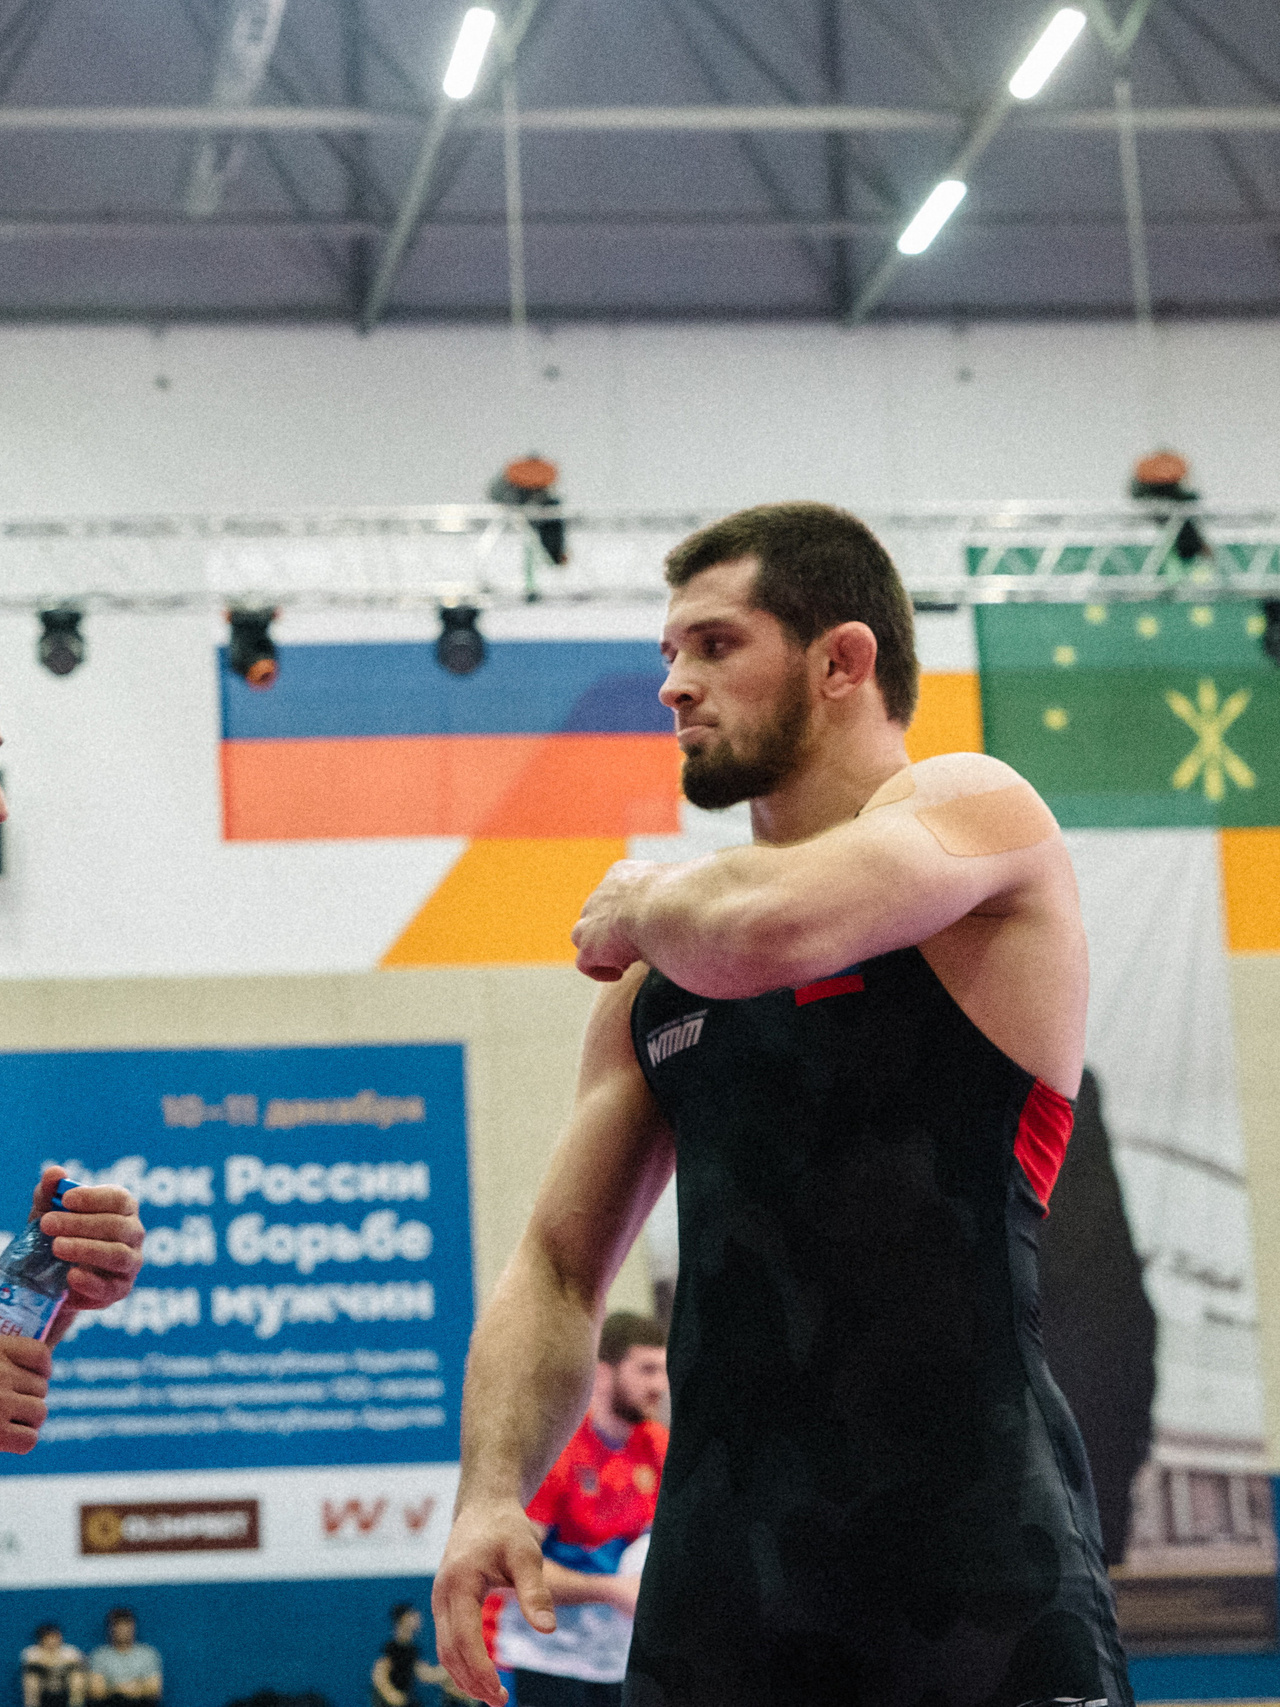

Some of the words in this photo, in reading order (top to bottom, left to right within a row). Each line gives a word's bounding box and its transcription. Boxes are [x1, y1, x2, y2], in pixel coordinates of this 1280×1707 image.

[224, 1153, 431, 1204] России
[226, 1208, 433, 1275] борьбе
[211, 1279, 435, 1340] мужчин
